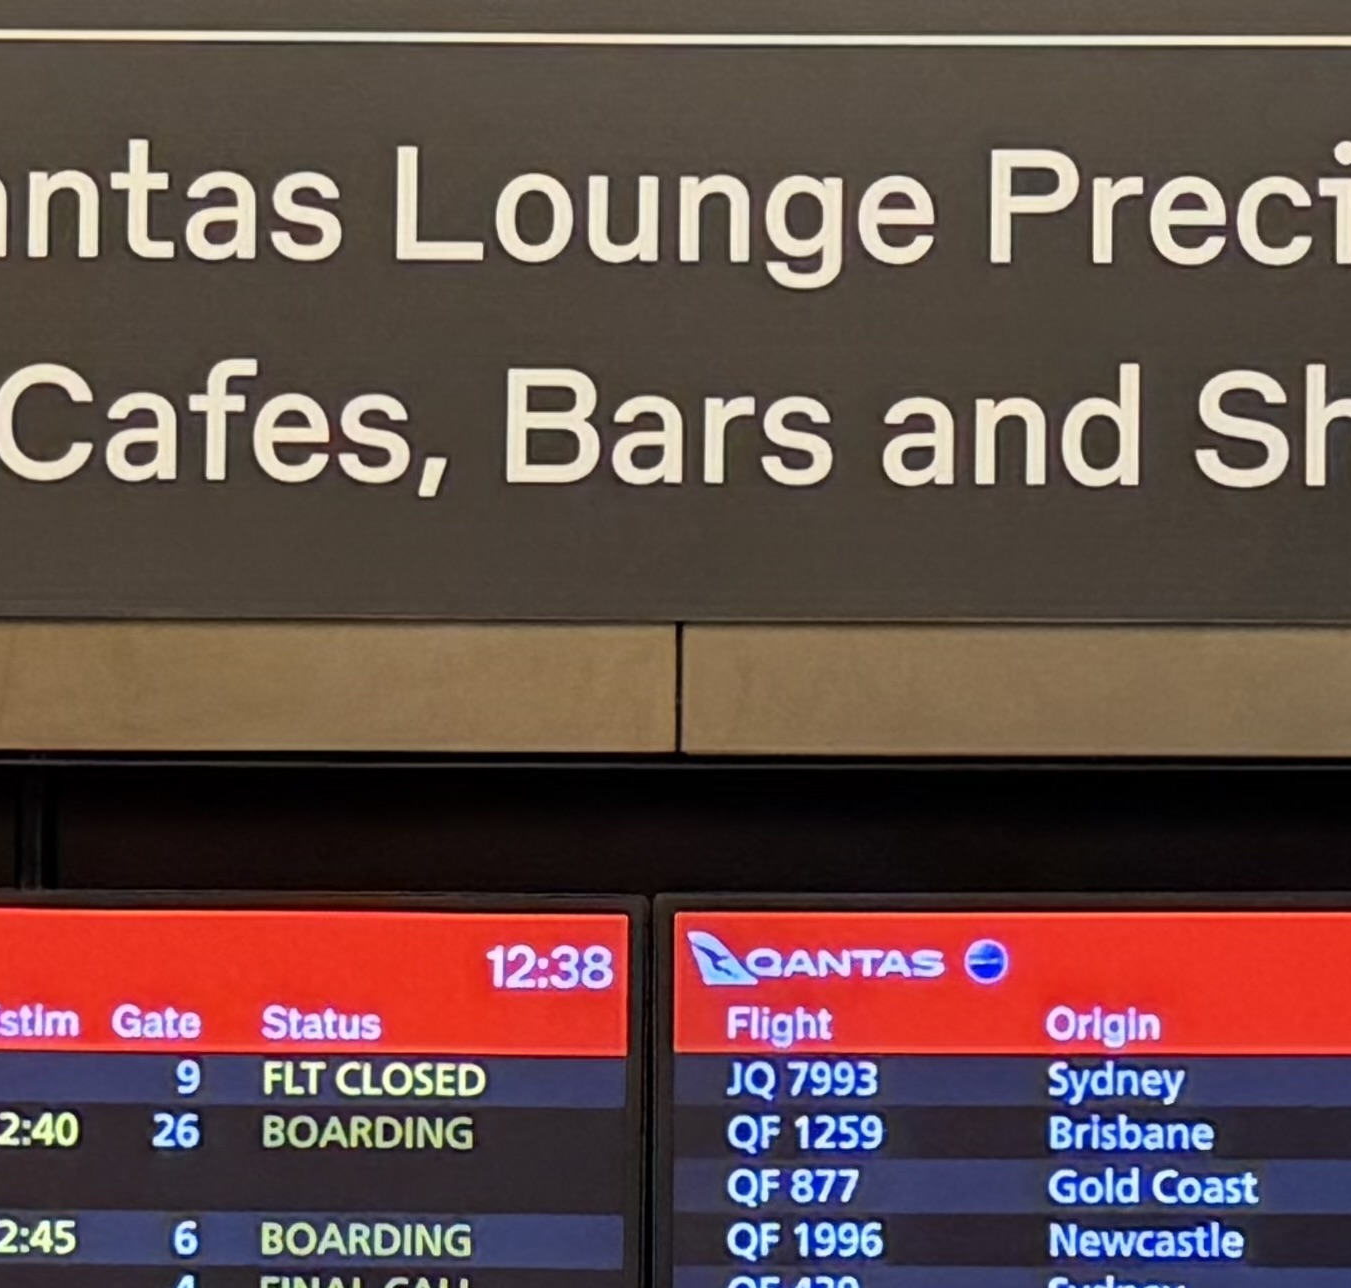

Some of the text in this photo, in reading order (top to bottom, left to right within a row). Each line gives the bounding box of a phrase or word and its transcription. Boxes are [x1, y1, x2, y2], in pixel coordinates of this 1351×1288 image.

[395, 144, 936, 290] Lounge
[505, 367, 834, 487] Bars
[881, 362, 1141, 488] and
[485, 943, 615, 990] 12:38
[747, 948, 946, 979] QANTAS
[111, 1003, 202, 1040] Gate
[261, 1004, 383, 1041] Status
[726, 1005, 833, 1049] Flight
[1045, 1005, 1162, 1049] Origin
[175, 1058, 202, 1095] 9
[262, 1059, 328, 1096] FLT
[334, 1060, 487, 1098] CLOSED
[725, 1060, 777, 1102] JQ
[786, 1060, 879, 1097] 7993
[1047, 1059, 1186, 1107] Sydney
[151, 1112, 201, 1149] 26
[262, 1114, 474, 1151] BOARDING
[726, 1114, 782, 1155] QF
[793, 1114, 884, 1151] 1259
[1049, 1113, 1216, 1152] Brisbane
[726, 1167, 782, 1209] QF
[789, 1167, 861, 1204] 877
[1047, 1166, 1141, 1205] Gold
[1151, 1168, 1260, 1205] Coast
[173, 1219, 199, 1256] 6
[260, 1221, 473, 1258] BOARDING
[726, 1221, 782, 1263] QF
[792, 1221, 885, 1259] 1996
[1048, 1220, 1245, 1259] Newcastle
